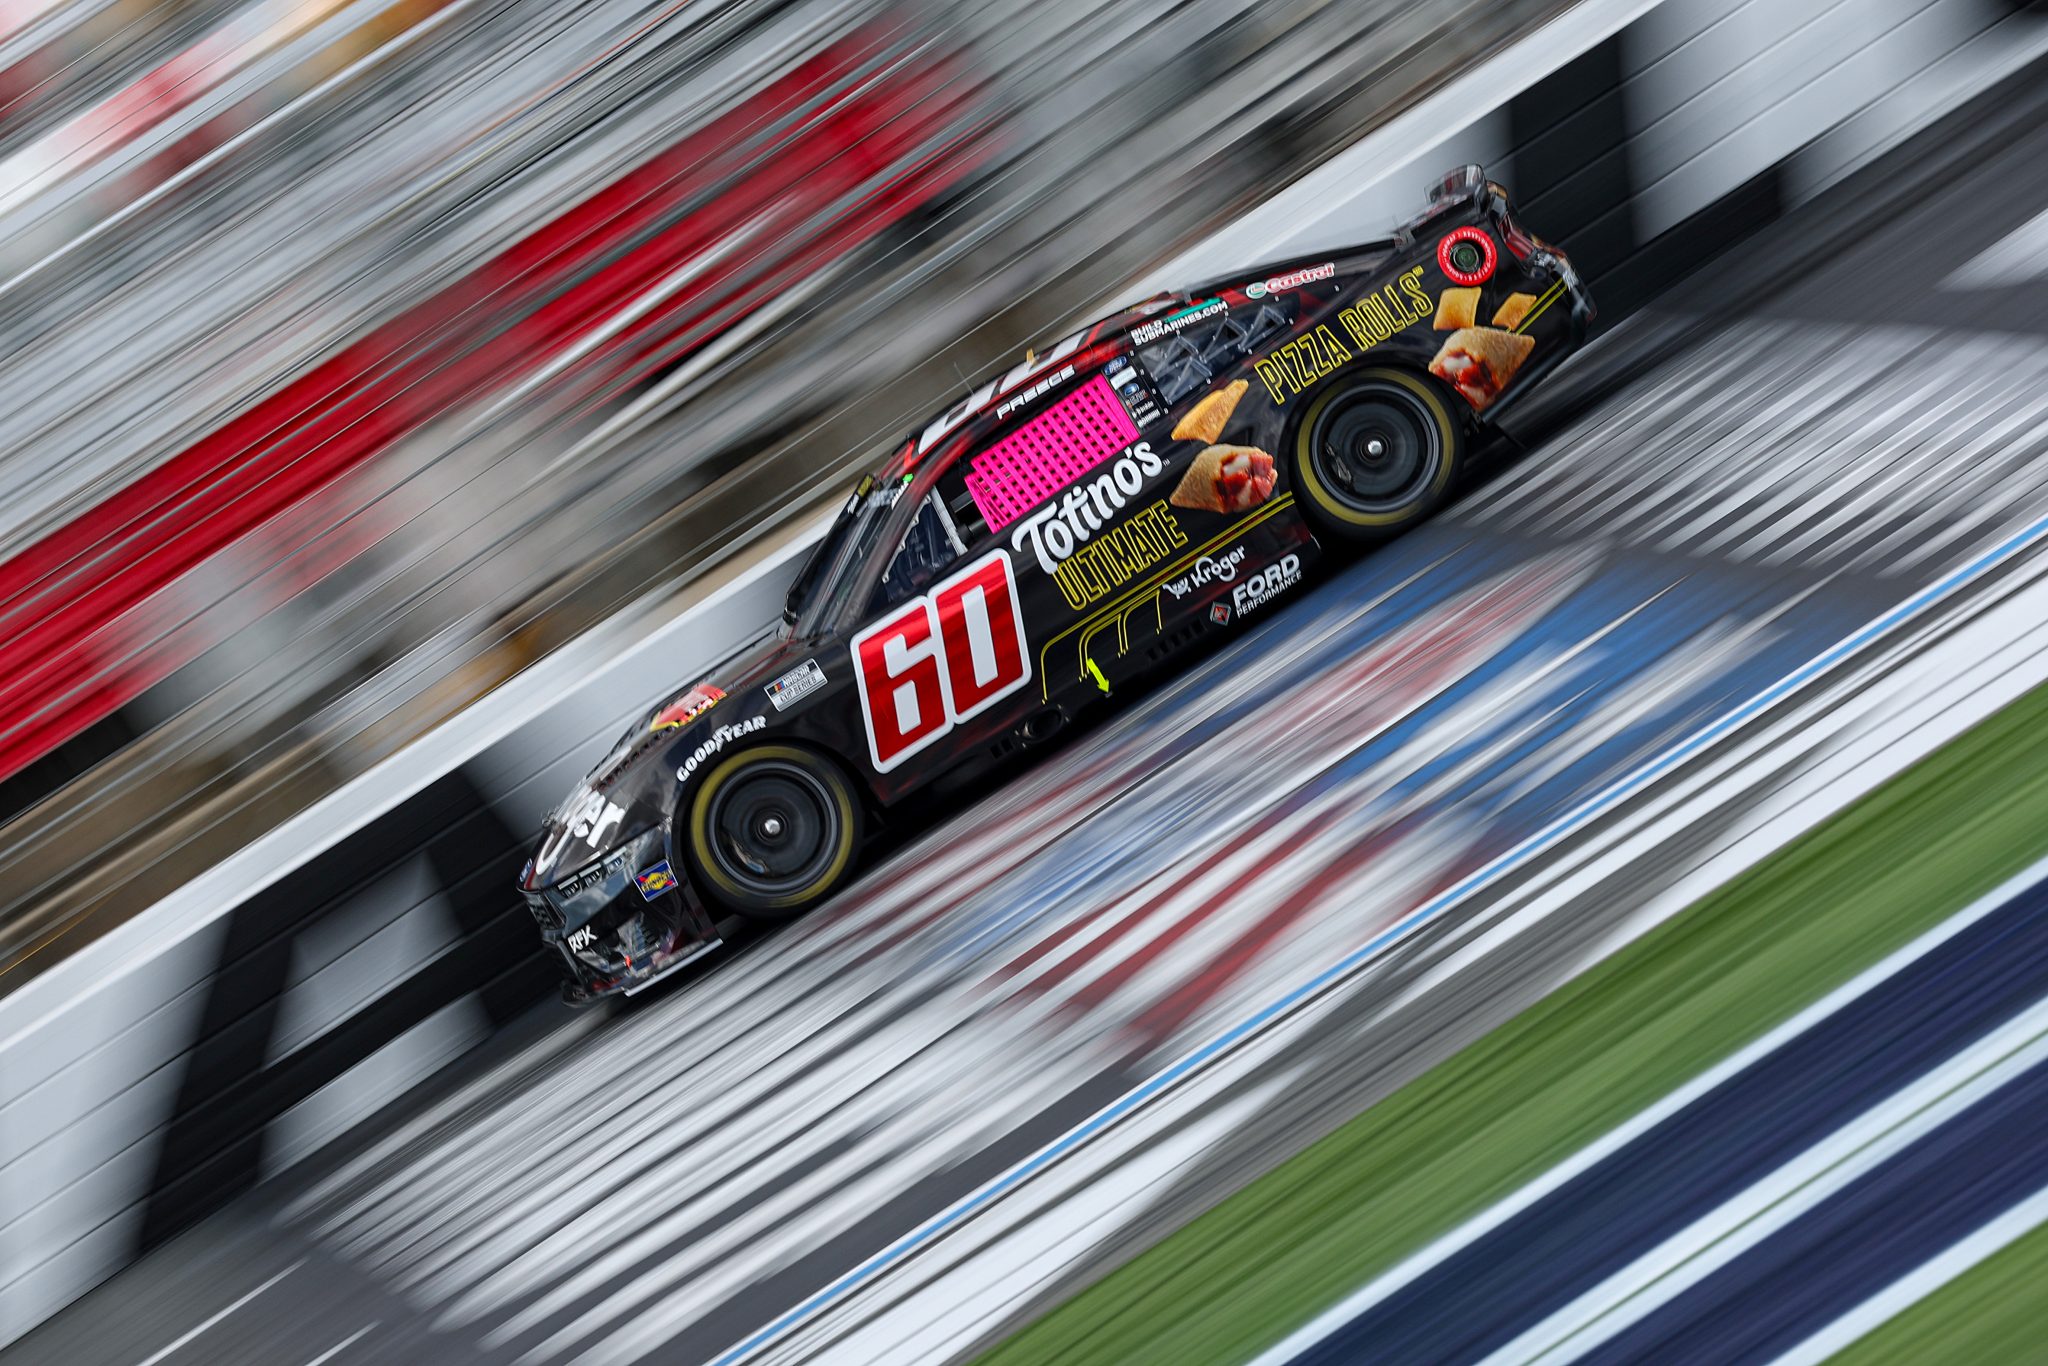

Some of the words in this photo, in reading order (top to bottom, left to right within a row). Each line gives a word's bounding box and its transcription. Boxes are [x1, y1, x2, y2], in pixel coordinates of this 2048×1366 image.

[1265, 262, 1335, 294] Castrol
[1130, 319, 1164, 340] BUILD
[1134, 300, 1229, 347] SUBMARINES.COM
[1253, 323, 1353, 406] PIZZA
[1338, 271, 1434, 352] ROLLS
[996, 364, 1076, 420] PREECE
[1011, 441, 1163, 575] Totino's
[1052, 499, 1189, 611] ULTIMATE
[1190, 545, 1246, 588] Kroger
[1232, 553, 1301, 610] FORD
[1235, 569, 1303, 619] PERFORMANCE
[781, 664, 811, 688] NASCAR
[851, 548, 1032, 774] 60
[675, 714, 767, 782] GOODYEAR
[567, 924, 598, 955] RFK
